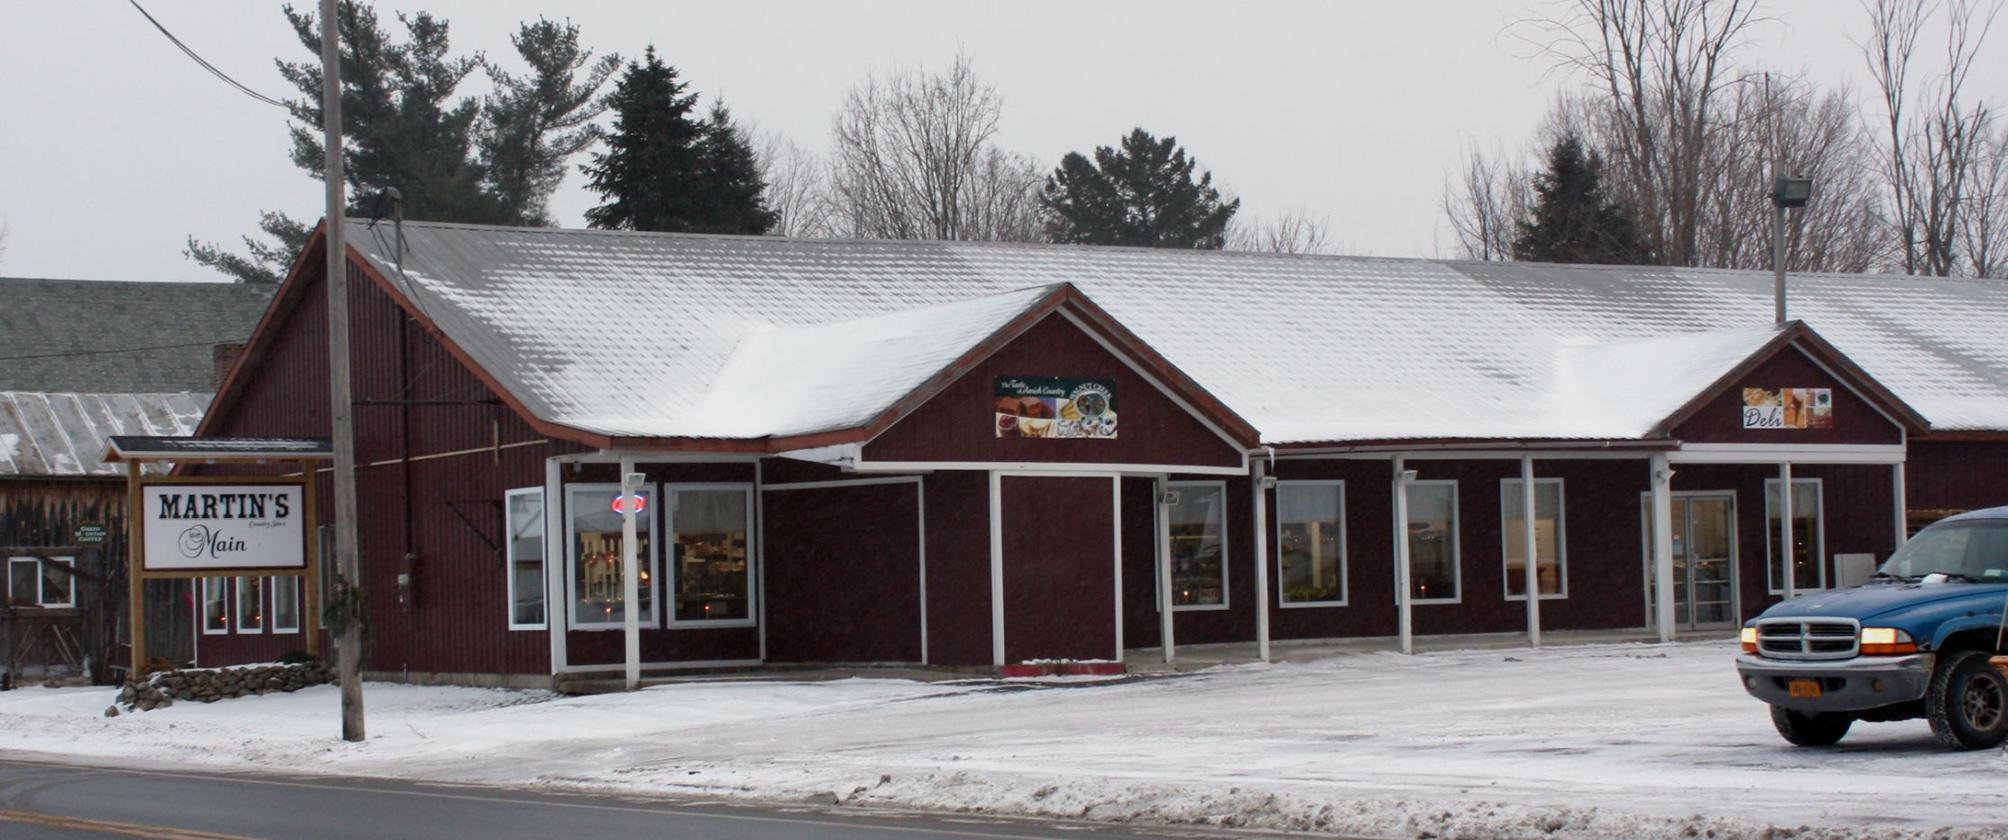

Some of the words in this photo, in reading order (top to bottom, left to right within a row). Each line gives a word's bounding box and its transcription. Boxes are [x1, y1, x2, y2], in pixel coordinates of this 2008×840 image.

[1743, 407, 1782, 427] Deli
[158, 493, 290, 519] MARTIN'S
[178, 524, 247, 559] Main
